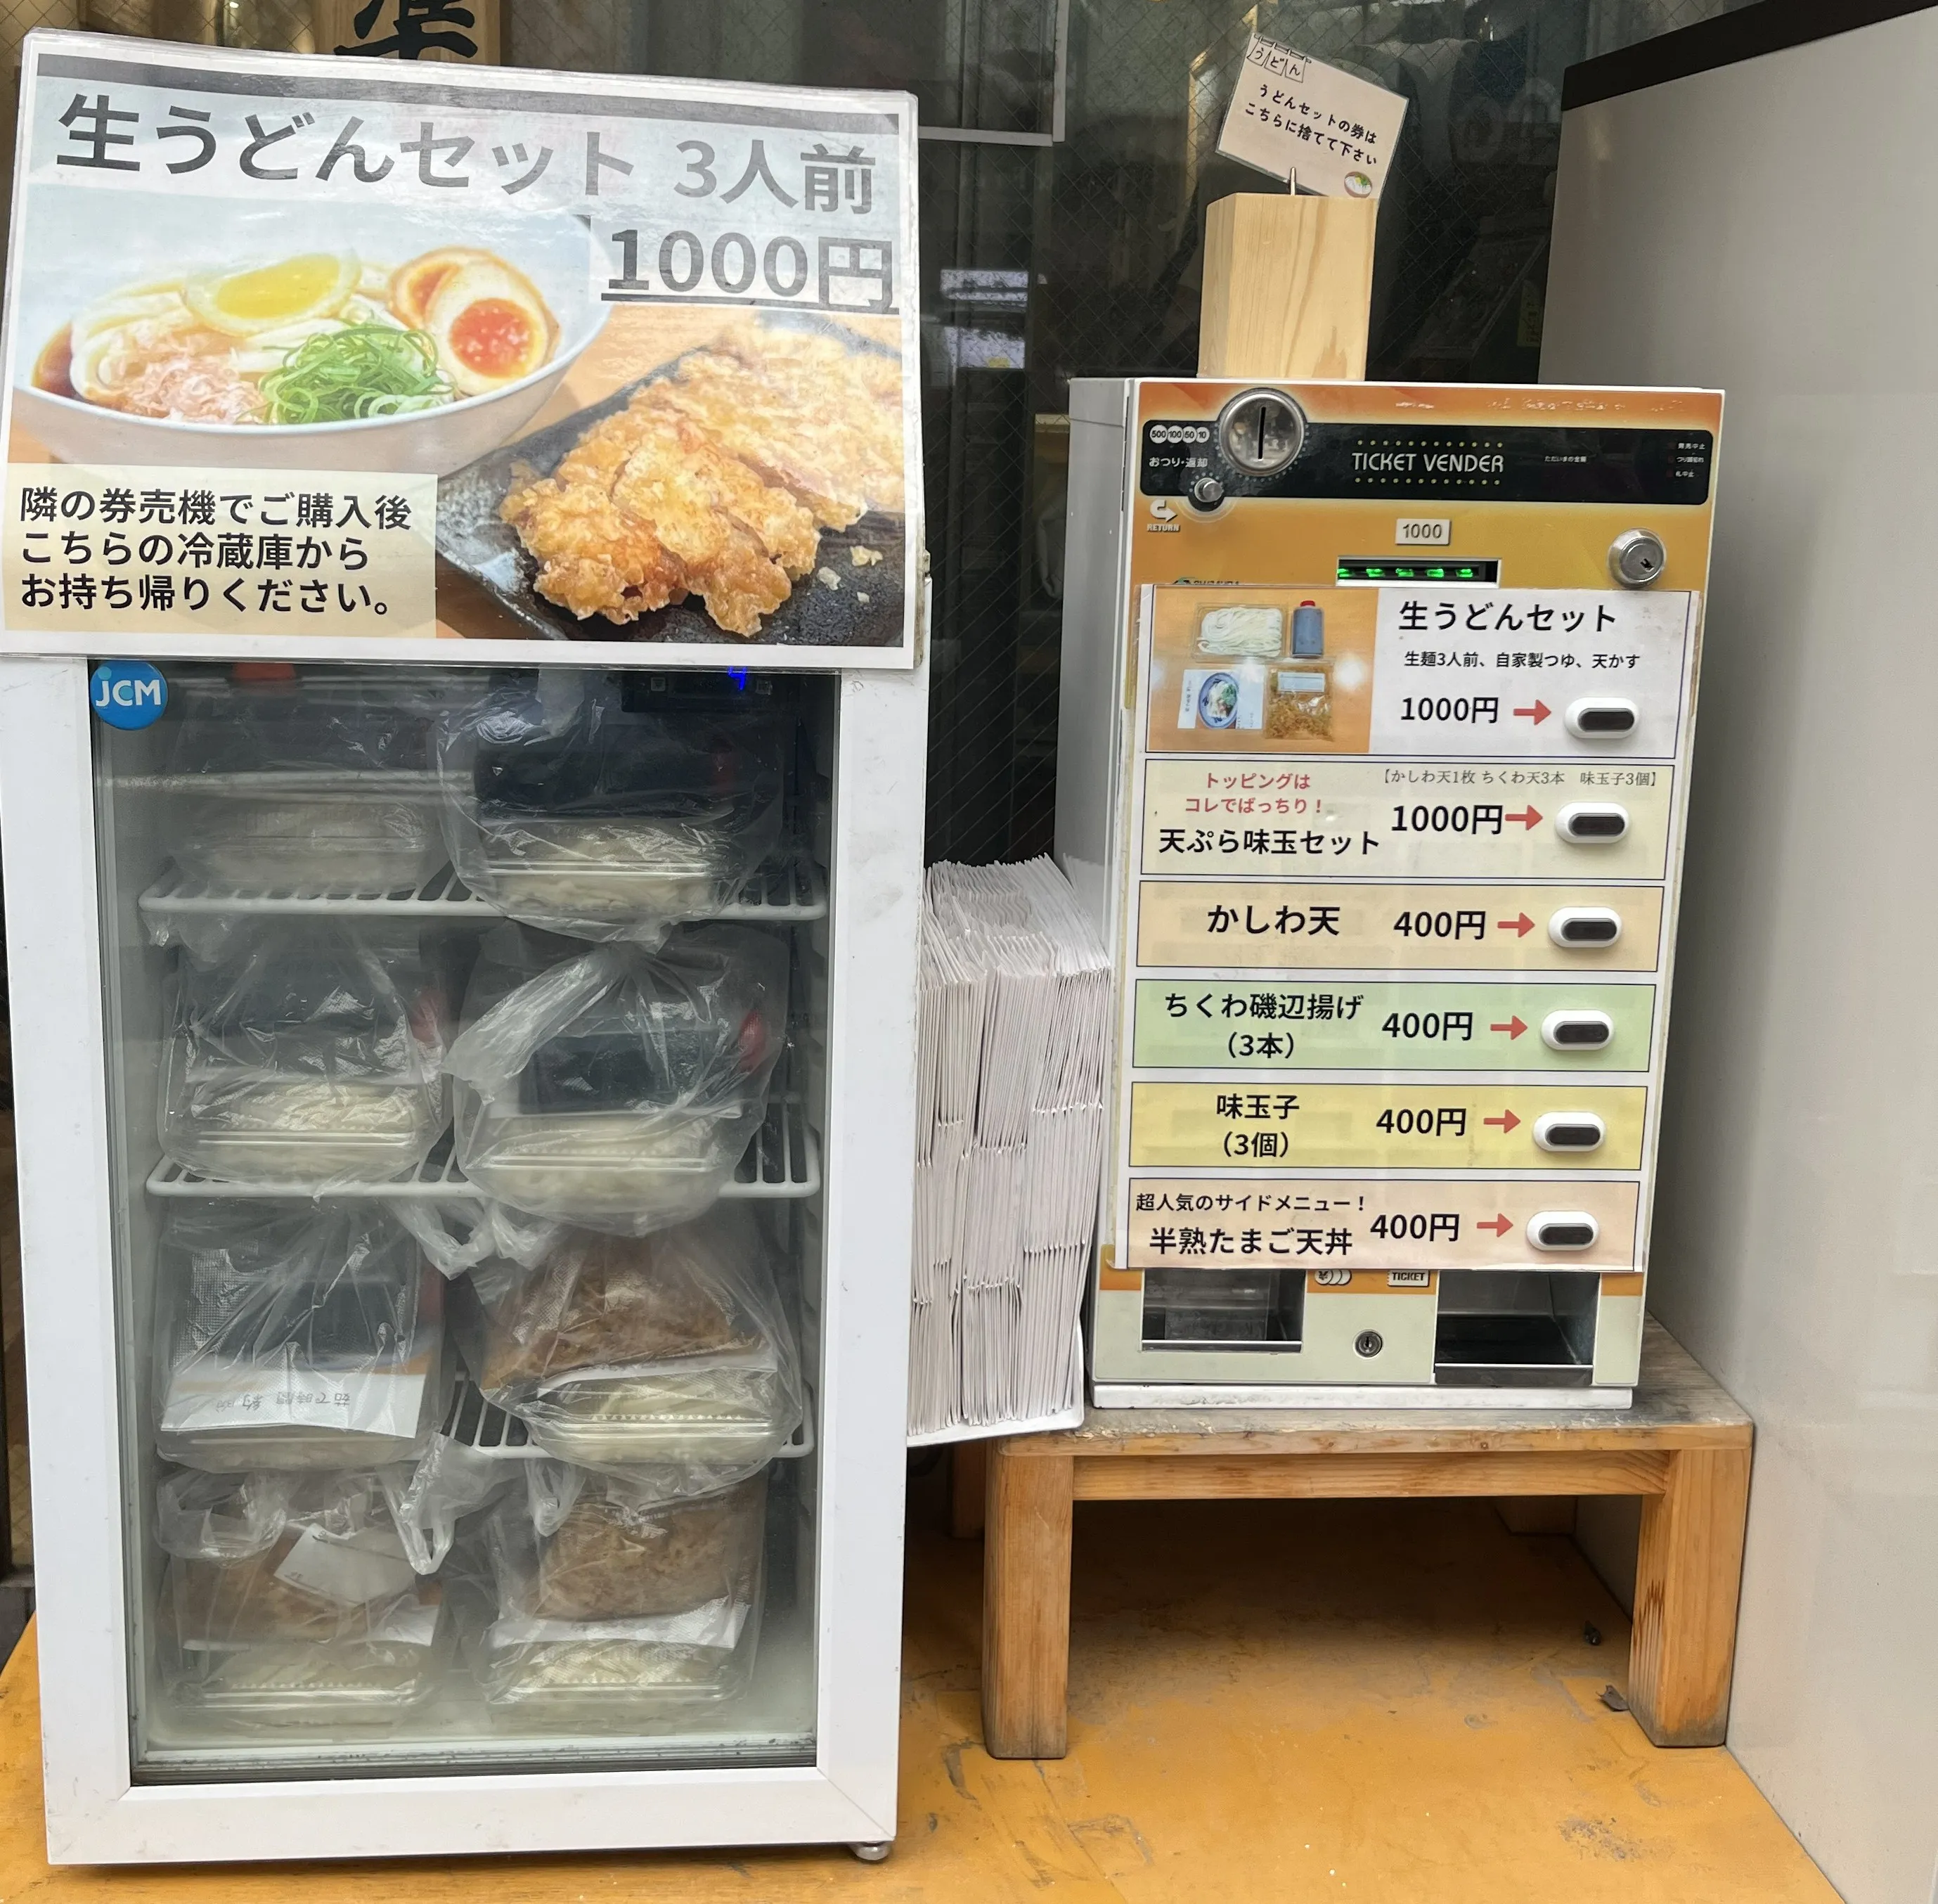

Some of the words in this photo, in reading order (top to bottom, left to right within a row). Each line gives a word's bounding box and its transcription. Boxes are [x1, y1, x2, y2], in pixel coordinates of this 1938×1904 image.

[1260, 84, 1376, 144] うどんセットの券は
[1245, 103, 1376, 165] こちらに捨てて下さい
[57, 94, 633, 196] 生うどんセット
[673, 139, 876, 214] 3人前
[607, 229, 893, 311] 1000円
[1151, 430, 1166, 438] 500
[1351, 452, 1416, 471] TICKET
[1423, 454, 1504, 473] VENDER
[20, 486, 412, 531] 隣の券売機でご購入後
[1146, 523, 1180, 532] RETURN
[1402, 523, 1442, 539] 1000
[22, 531, 368, 570] こちらの冷蔵庫から
[21, 572, 388, 615] お持ち帰りください。
[1399, 600, 1615, 633] 生うどんセット
[1404, 651, 1640, 669] 生麺3人前、自家製つゆ、天かす
[1400, 696, 1499, 724] 1000円
[1207, 773, 1310, 790] トッピングは
[1482, 771, 1565, 785] ちくわ天3本
[1391, 804, 1504, 835] 1000円
[1159, 828, 1379, 856] 天ぷら味玉セット
[1207, 904, 1341, 936] かしわ天
[1393, 911, 1486, 940] 400円
[1165, 992, 1364, 1021] ちくわ磯辺揚げ
[1382, 1011, 1473, 1041] 400円
[1216, 1093, 1300, 1121] 味玉子
[1376, 1106, 1468, 1137] 400円
[1135, 1193, 1366, 1213] 超人気のサイドメニュー！
[1149, 1226, 1353, 1256] 半熟たまご天丼
[1370, 1211, 1460, 1242] 400円
[1392, 1272, 1426, 1281] TICKET
